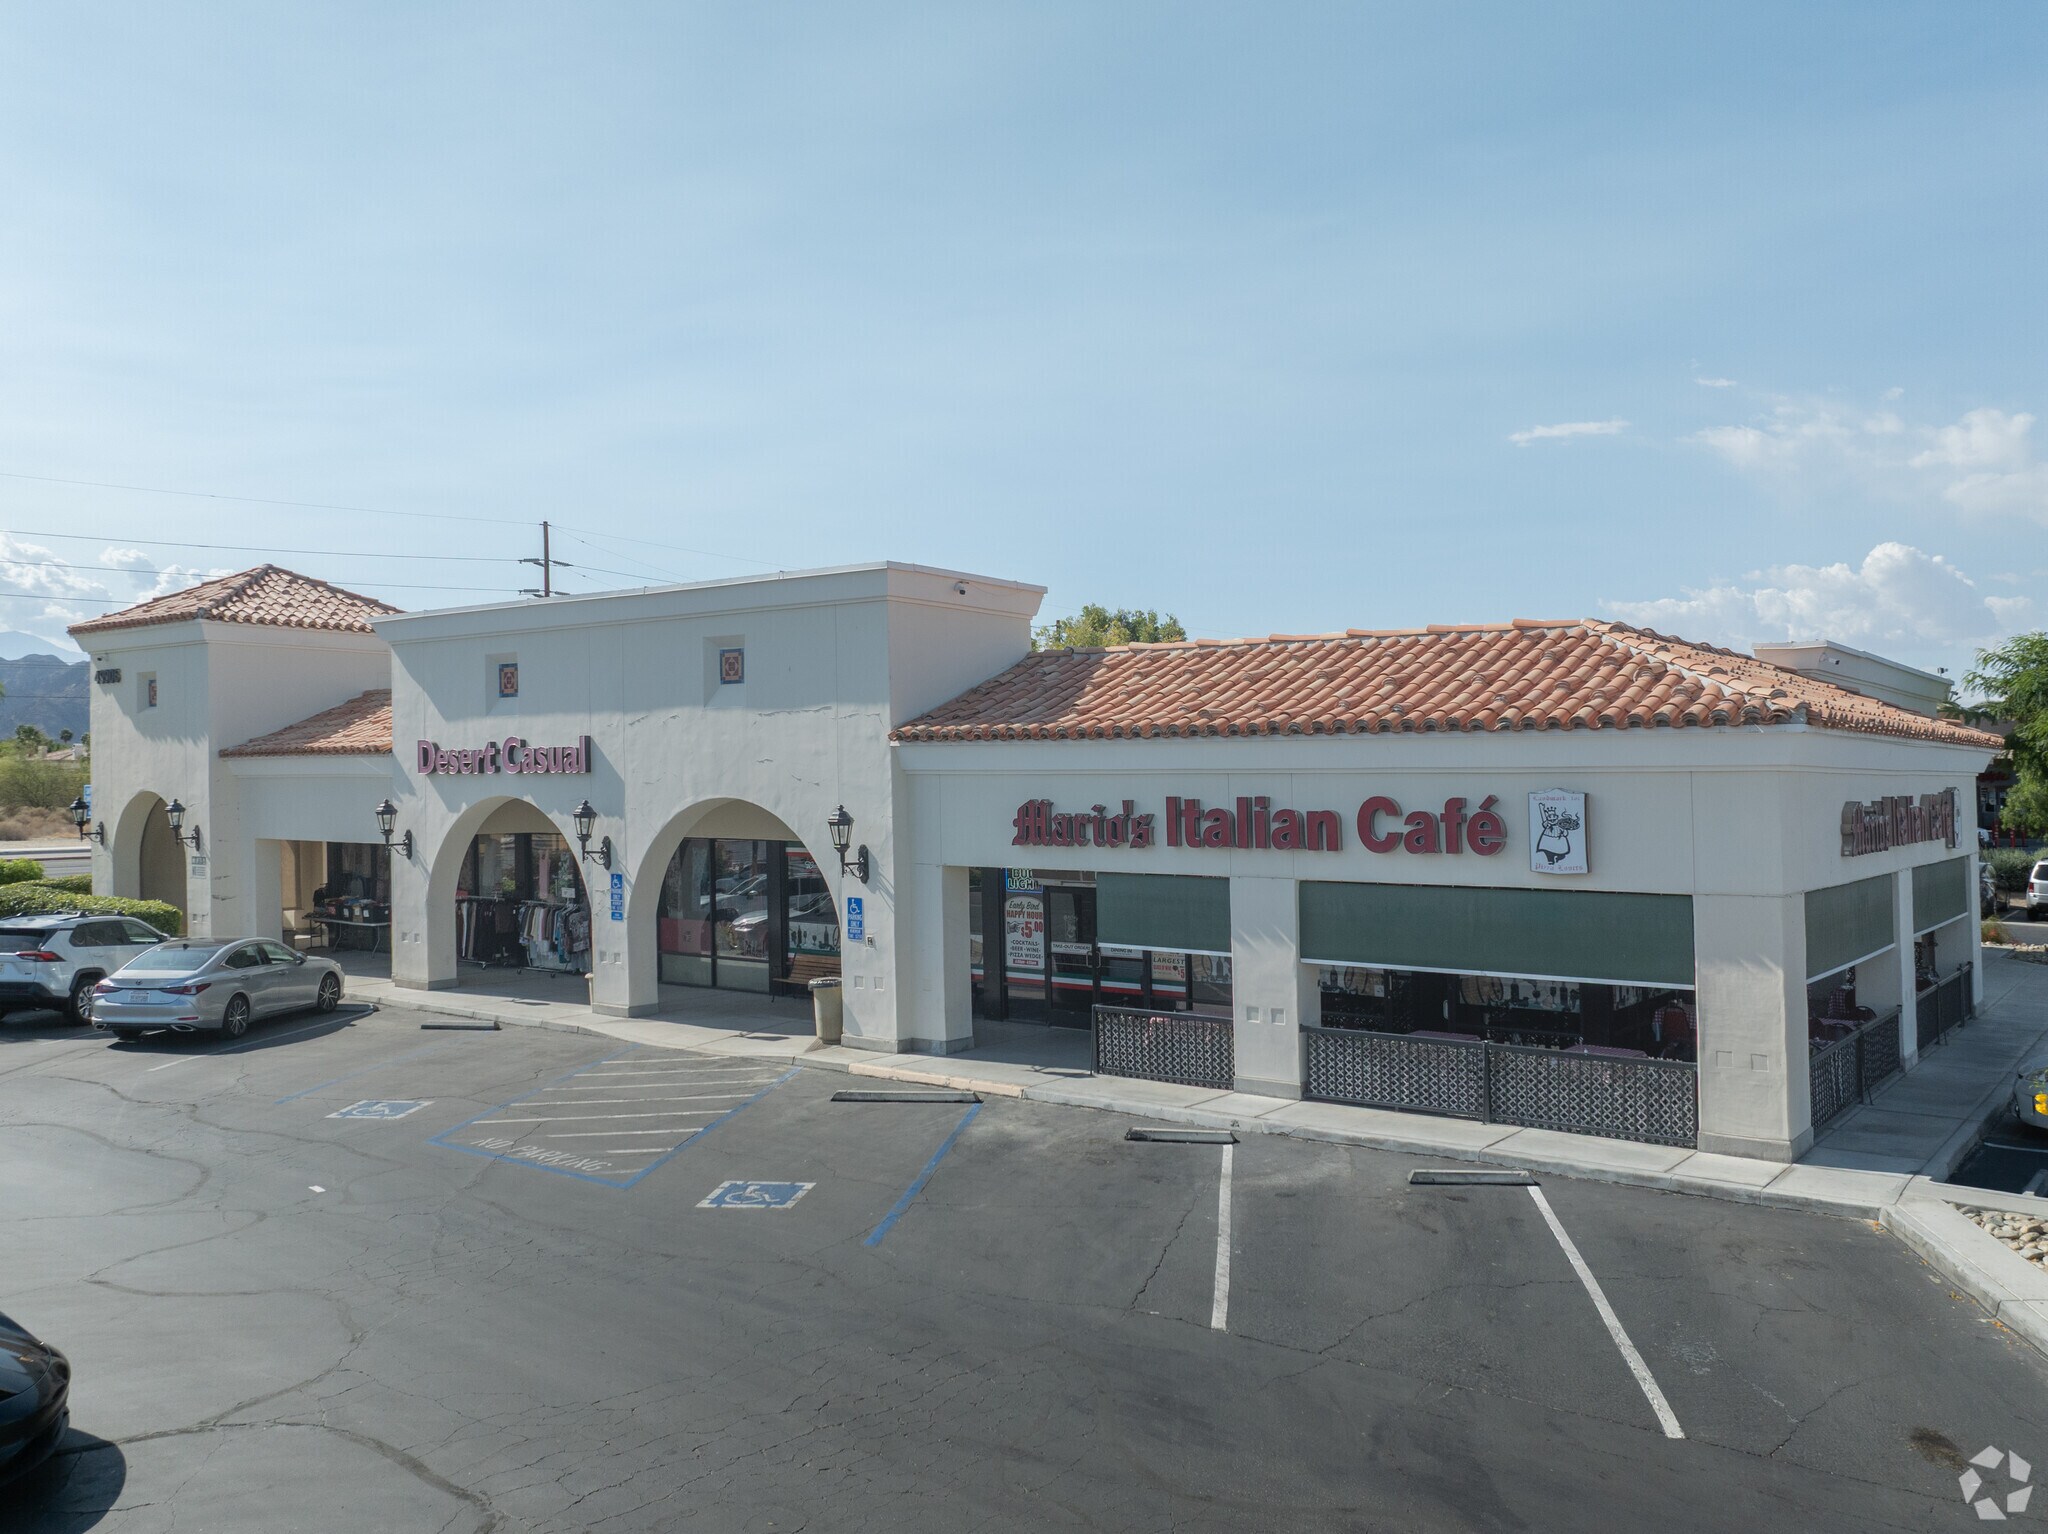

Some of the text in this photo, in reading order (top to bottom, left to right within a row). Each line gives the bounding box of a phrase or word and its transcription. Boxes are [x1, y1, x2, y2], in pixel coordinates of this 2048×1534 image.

[417, 735, 591, 774] Desert Casual
[1011, 794, 1507, 857] Mario's Italian Café
[1007, 910, 1043, 919] HAPPY HOUR
[1009, 901, 1040, 912] Early Bird
[1021, 921, 1043, 938] $5.00
[1153, 957, 1185, 965] LARGEST
[470, 1137, 606, 1172] NO PARKING
